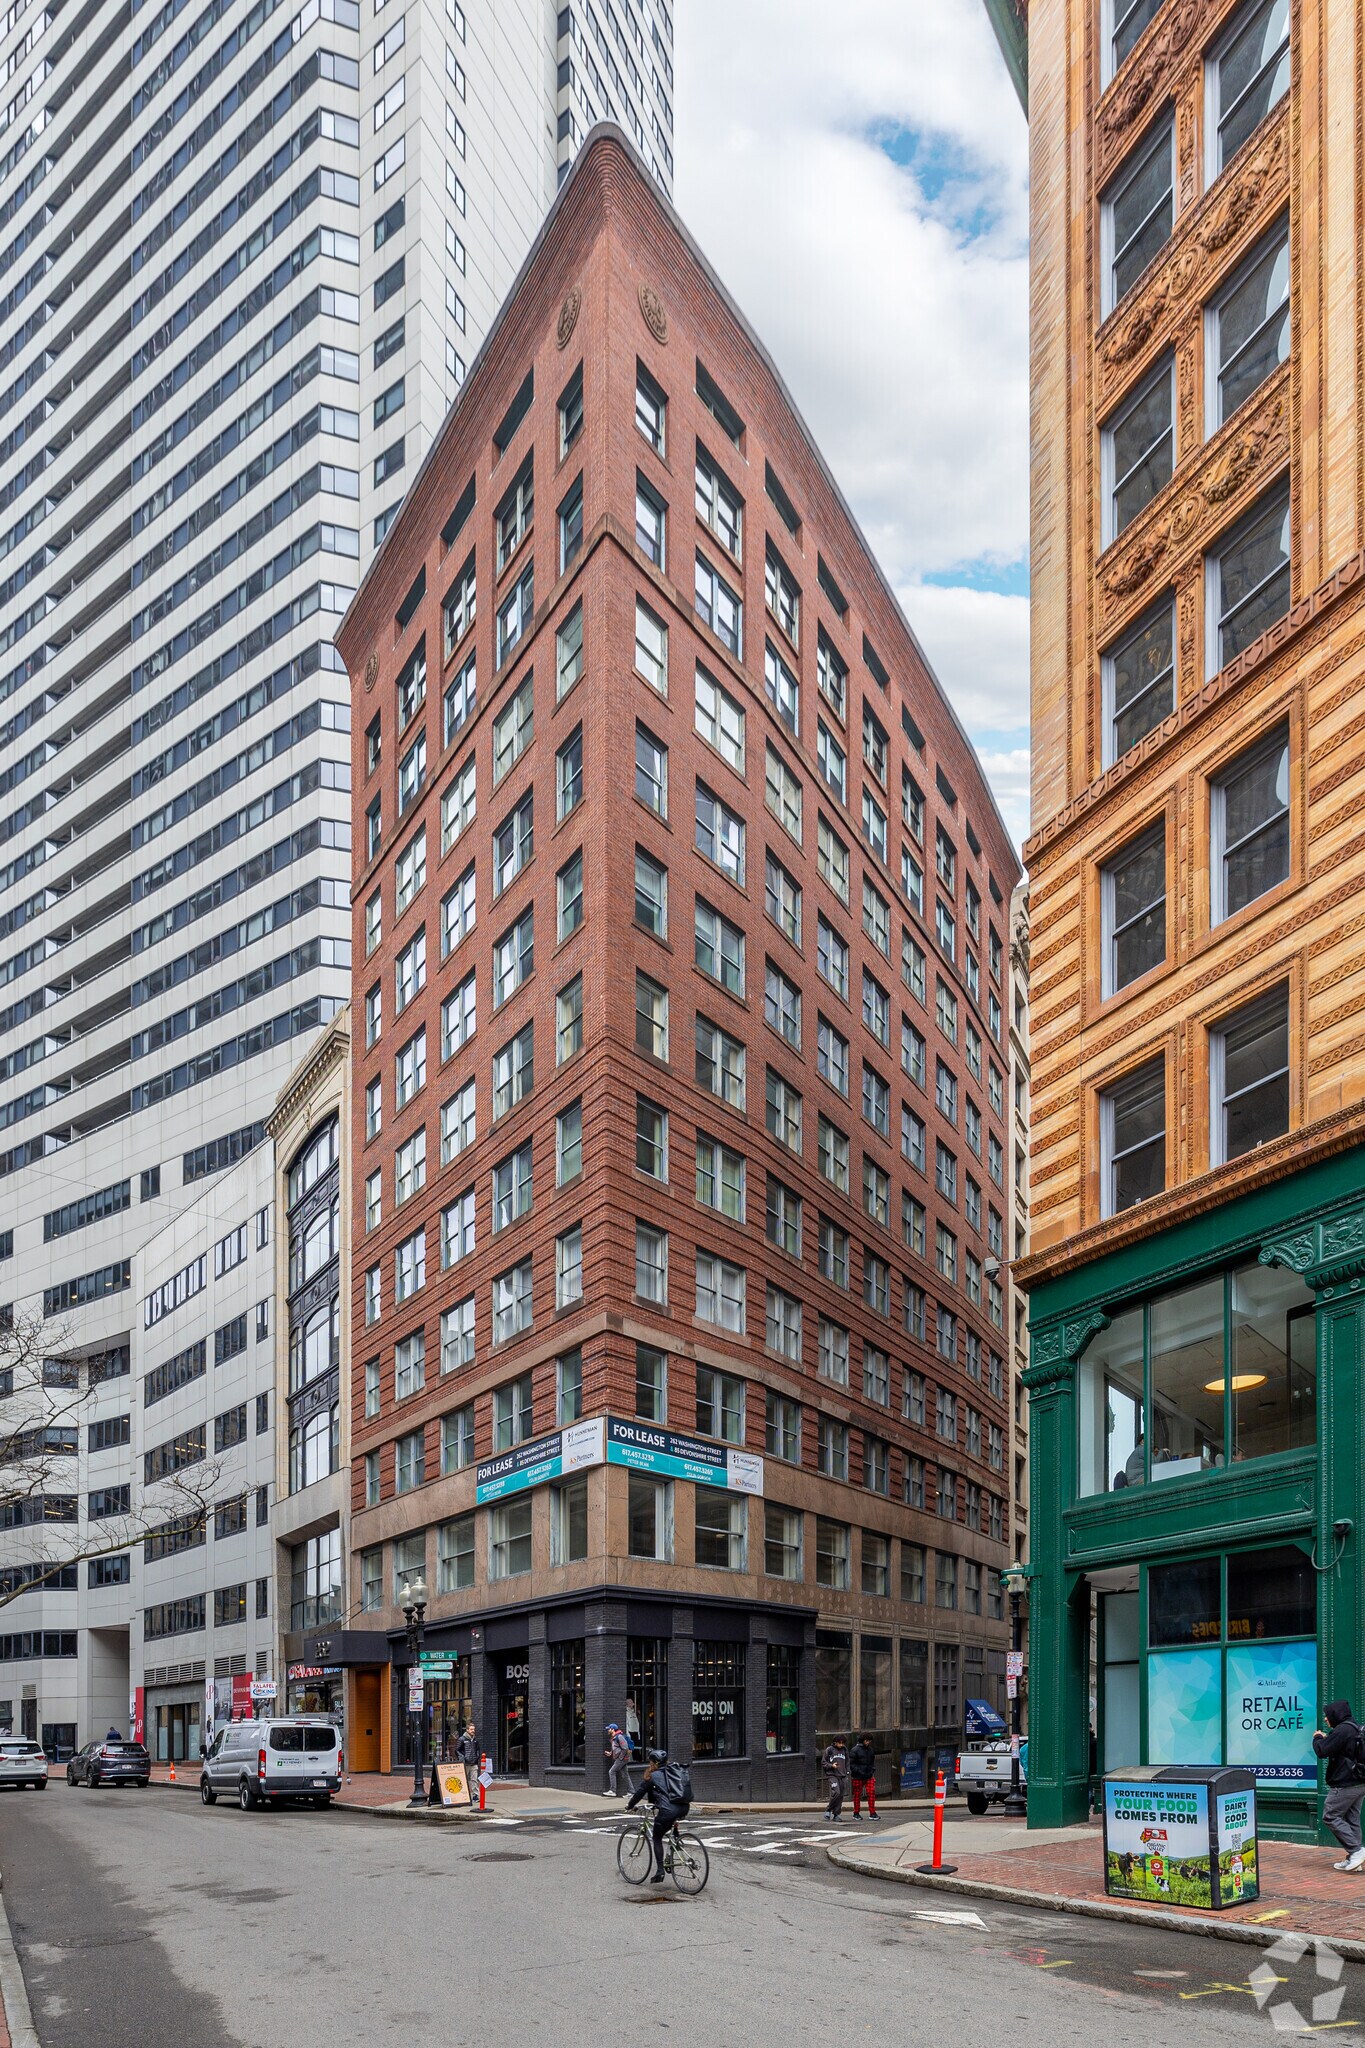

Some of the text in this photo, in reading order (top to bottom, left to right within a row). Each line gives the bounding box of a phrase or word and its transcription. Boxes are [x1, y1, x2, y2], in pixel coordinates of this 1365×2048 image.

[613, 1424, 665, 1448] FOR LEASE
[523, 1442, 546, 1457] WASHINGTON
[546, 1437, 560, 1448] STREET
[546, 1446, 560, 1456] STREET
[678, 1440, 707, 1452] WASHINGTON
[707, 1447, 722, 1456] STREET
[707, 1455, 722, 1464] STREET
[478, 1457, 513, 1480] FOR LEASE
[692, 1701, 734, 1715] BOSON
[1242, 1696, 1304, 1713] RETAIL
[1242, 1713, 1304, 1730] OR CAFÉ
[1114, 1790, 1197, 1800] PROTECTING WHERE
[1225, 1796, 1247, 1804] DISCOVER
[1114, 1798, 1197, 1813] YOUR FOOD
[1225, 1801, 1247, 1811] DAIRY
[1115, 1810, 1198, 1824] COMES FROM
[1225, 1812, 1247, 1823] GOOD
[1225, 1820, 1248, 1830] ABOUT
